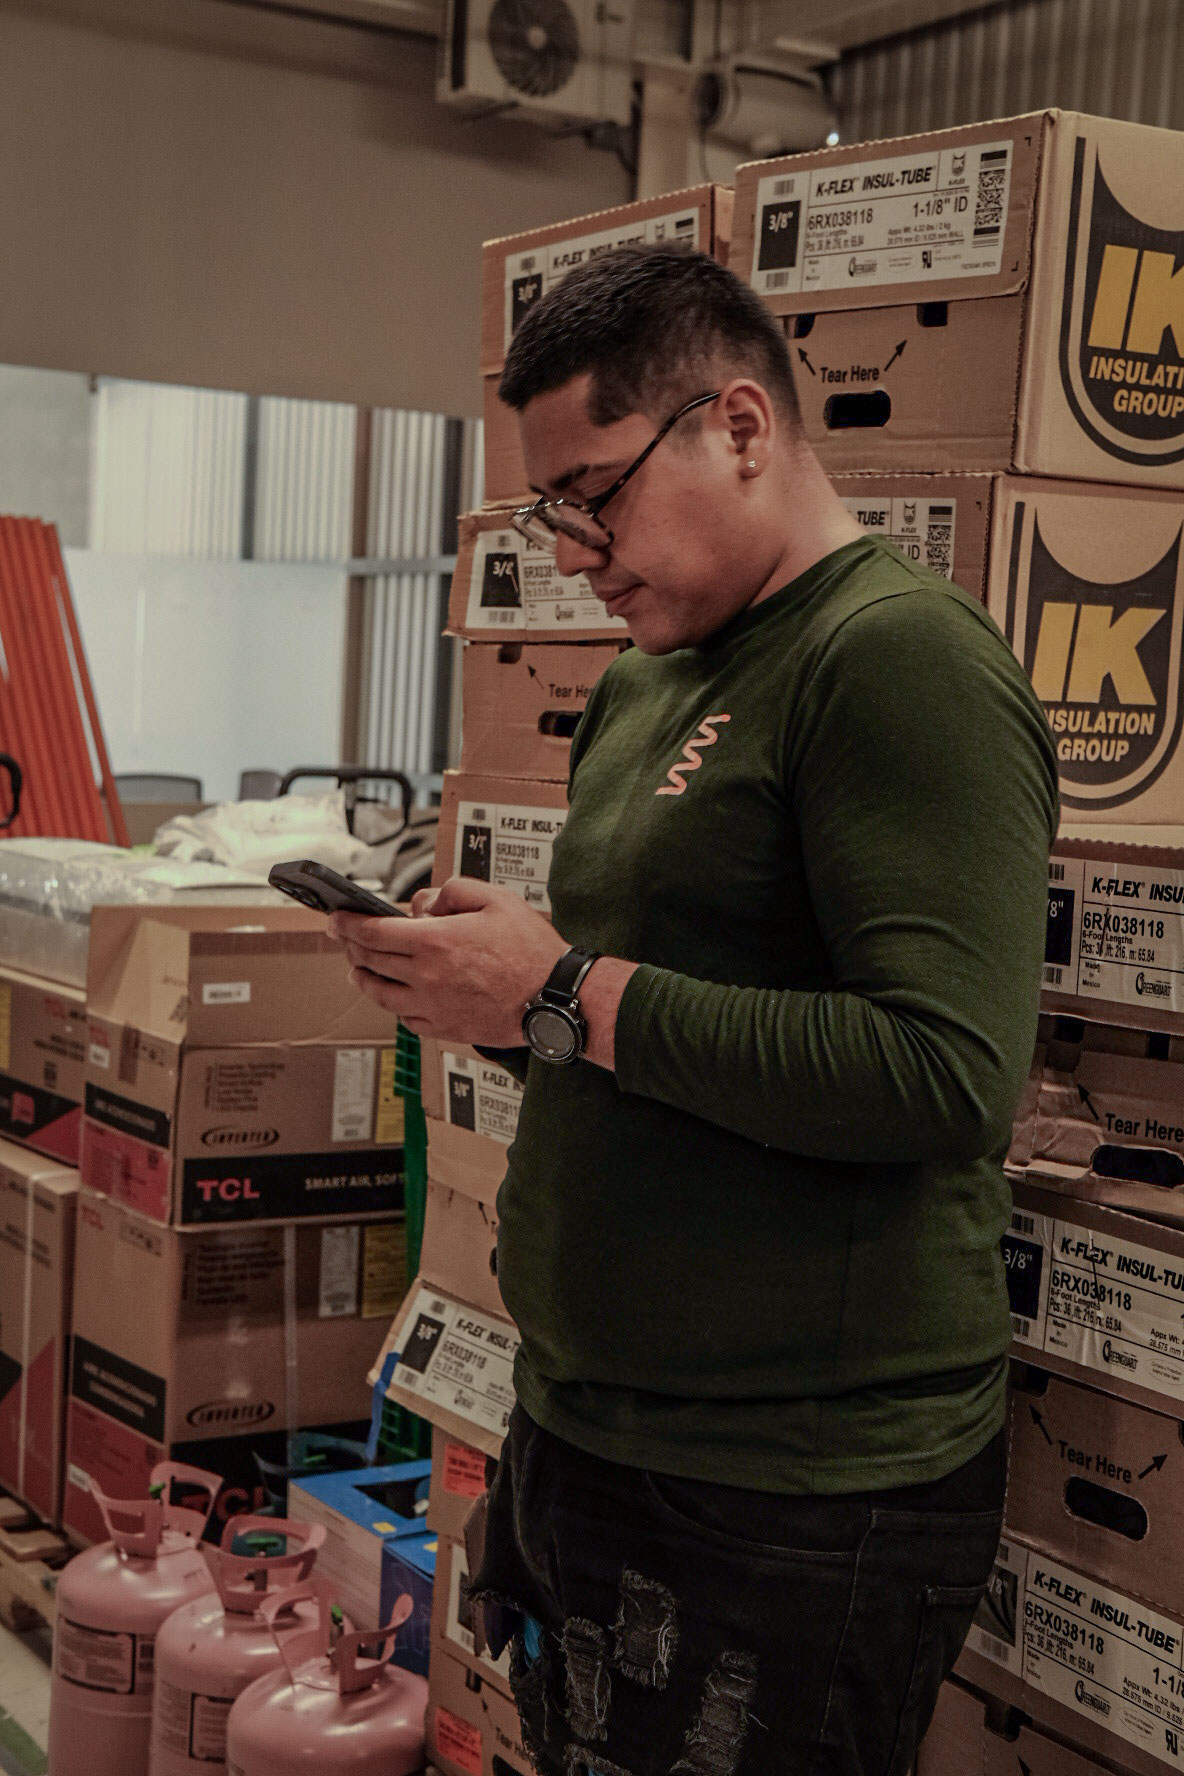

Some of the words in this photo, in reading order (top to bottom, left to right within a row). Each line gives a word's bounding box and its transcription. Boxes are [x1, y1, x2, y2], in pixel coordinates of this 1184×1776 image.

[816, 177, 855, 198] K-FLEX
[862, 166, 932, 191] INSUL-TUBE
[913, 197, 951, 218] 1-1/8"
[954, 195, 968, 213] ID
[768, 212, 793, 232] 3/8"
[808, 208, 873, 230] 6RX038118
[820, 365, 848, 384] Tear
[850, 364, 880, 382] Here
[1113, 388, 1184, 419] GROUP
[1032, 601, 1167, 706] IK
[549, 684, 573, 697] Tear
[1057, 738, 1129, 762] GROUP
[501, 817, 526, 831] K-FLEX
[1092, 877, 1142, 899] K-FLEX
[1149, 883, 1184, 904] INSU
[1083, 911, 1165, 939] 6RX038118
[1082, 930, 1104, 941] 6-Foo
[1106, 932, 1133, 945] Lengths
[1129, 949, 1137, 960] m:
[1138, 948, 1155, 962] 65.84
[1105, 1112, 1140, 1136] Tear
[1145, 1119, 1184, 1143] Here
[196, 1178, 261, 1203] TCL
[304, 1175, 346, 1192] SMART
[1004, 1248, 1033, 1270] 3/8"
[1061, 1237, 1111, 1267] K-FLEX
[1052, 1269, 1132, 1311] 6RX038118
[1073, 1294, 1101, 1311] Lengths
[1106, 1316, 1122, 1333] 65.84
[1150, 1328, 1167, 1340] Appx
[1149, 1338, 1168, 1352] 28.575
[1059, 1440, 1092, 1470] Tear
[1095, 1454, 1132, 1484] Here
[1033, 1570, 1083, 1607] K-FLEX
[1090, 1597, 1177, 1654] INSUL-TUBE
[1025, 1601, 1105, 1656] 6RX038118
[1046, 1629, 1074, 1650] Lengths
[1122, 1686, 1142, 1703] 28.575
[1142, 1699, 1154, 1711] mm
[1154, 1693, 1169, 1707] 4.32
